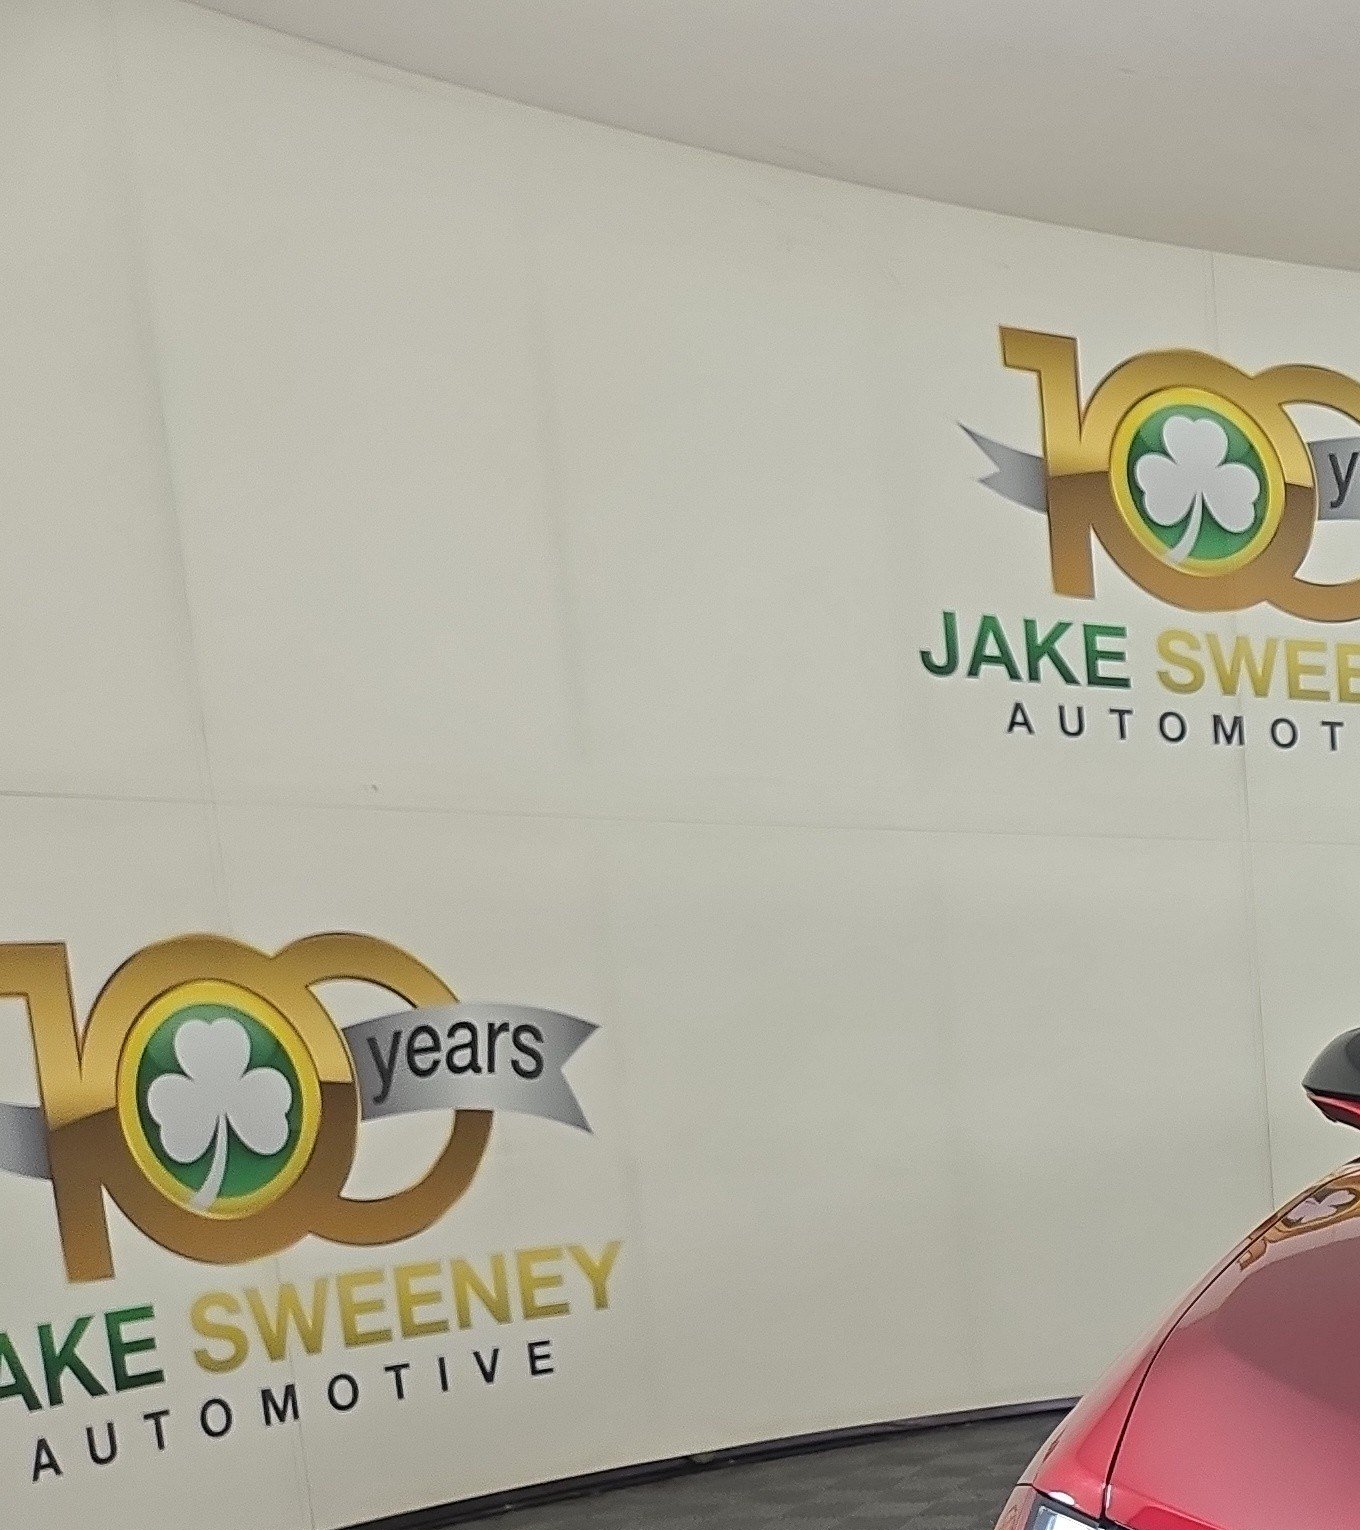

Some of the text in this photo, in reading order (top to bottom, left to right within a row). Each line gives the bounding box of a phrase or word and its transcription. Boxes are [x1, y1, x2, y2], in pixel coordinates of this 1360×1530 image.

[919, 610, 1133, 690] JAKE
[366, 1019, 546, 1104] years
[0, 1240, 624, 1412] AKE SWEENEY
[31, 1339, 556, 1482] AUTOMOTIVE
